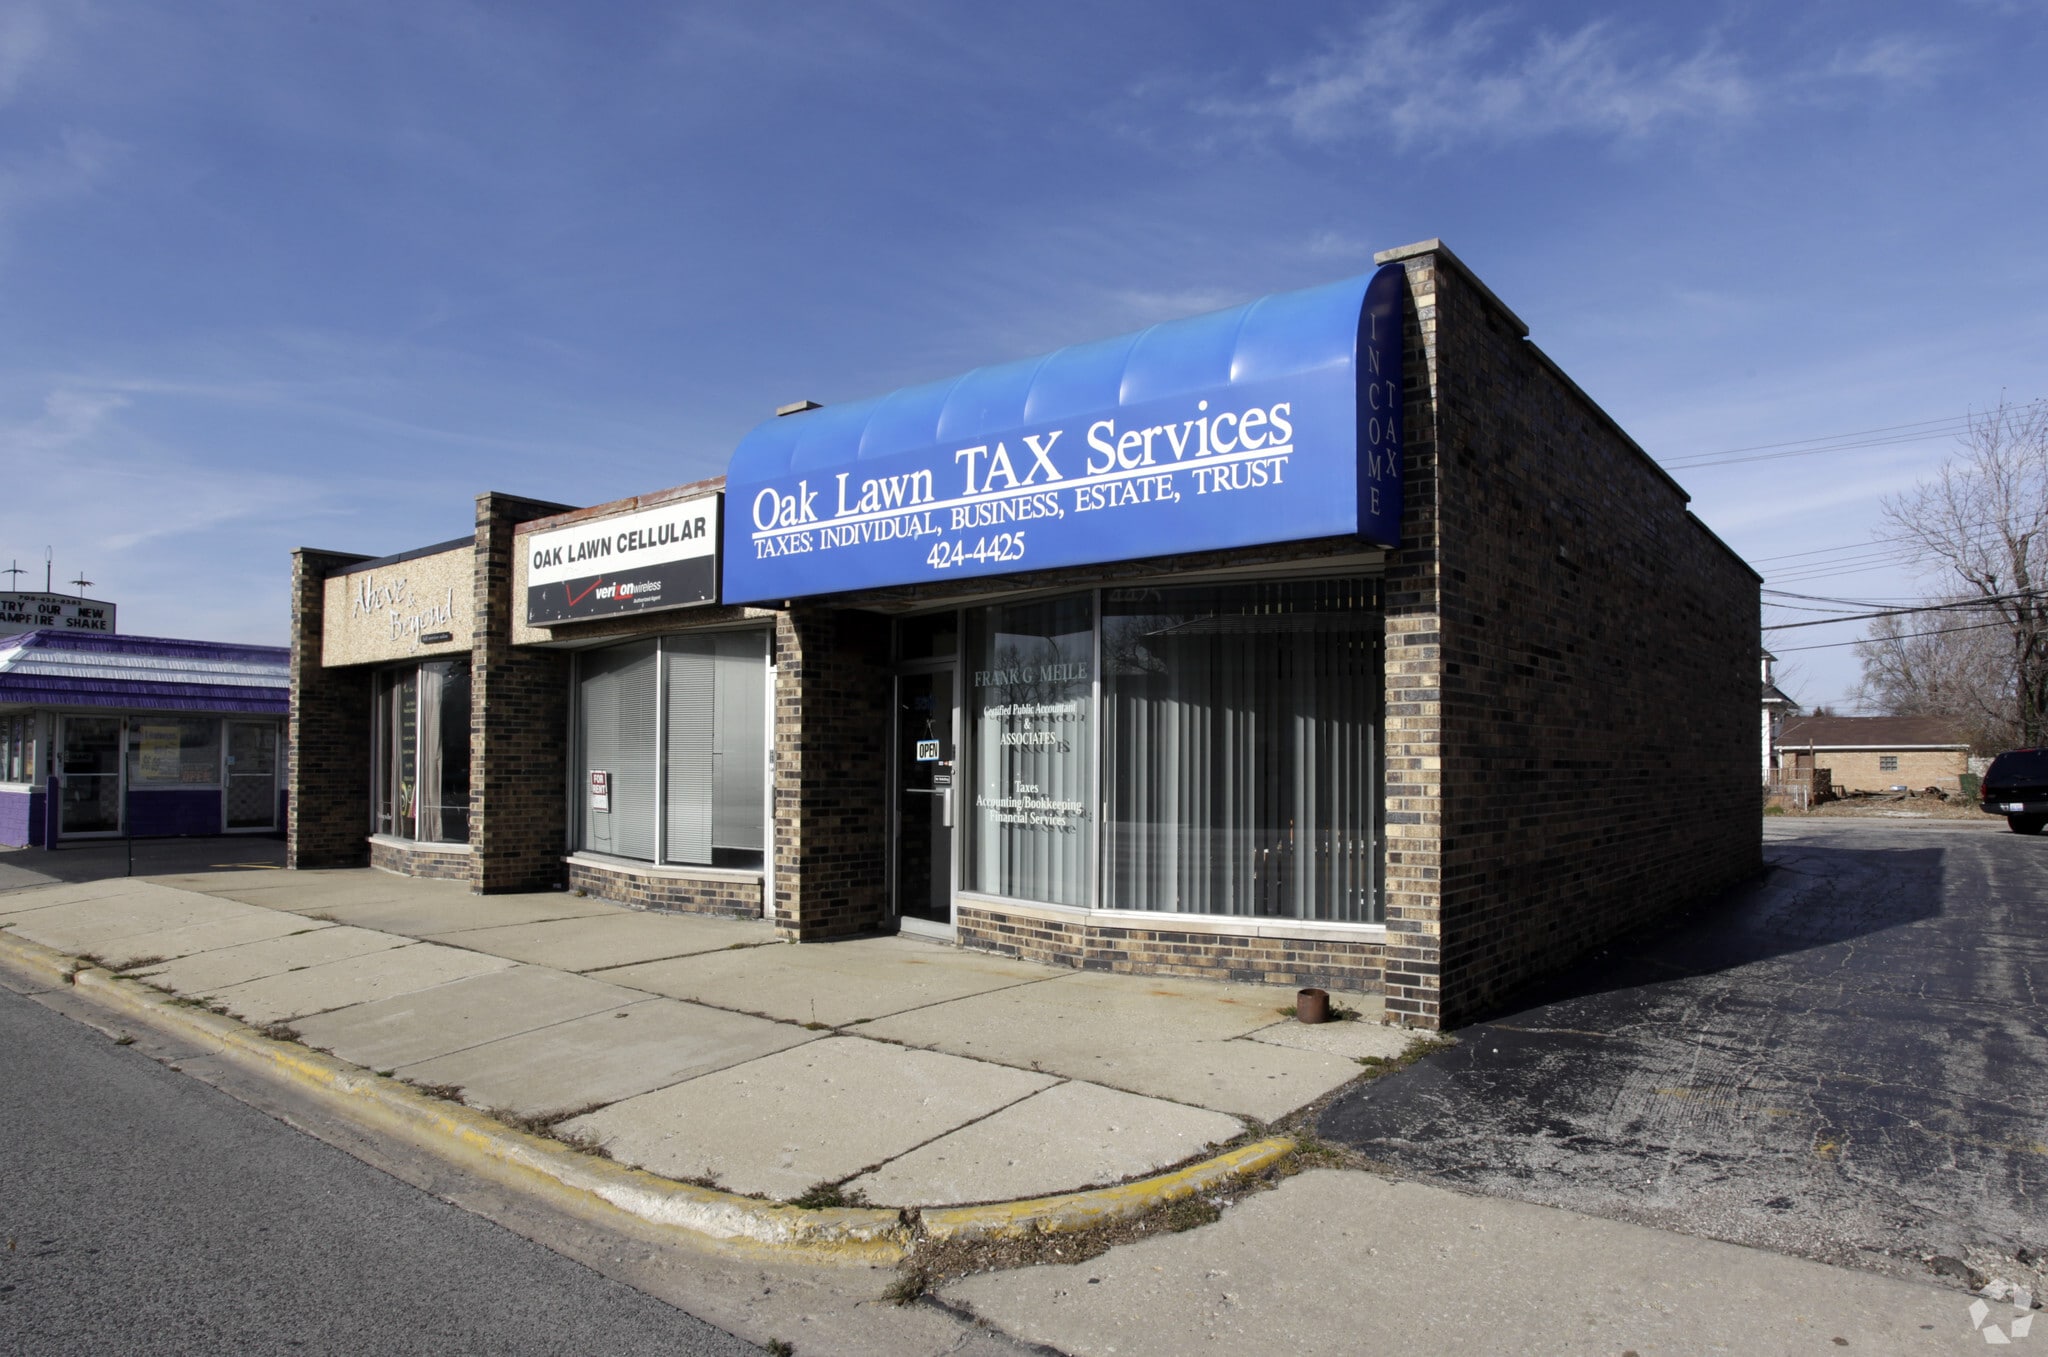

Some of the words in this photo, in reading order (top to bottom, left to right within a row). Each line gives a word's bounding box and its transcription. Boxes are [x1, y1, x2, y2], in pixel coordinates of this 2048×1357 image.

[1367, 312, 1382, 516] INCOME
[1385, 379, 1397, 478] TAX
[752, 480, 818, 530] Oak
[835, 469, 935, 517] Lawn
[955, 430, 1063, 496] TAX
[1087, 400, 1294, 475] Services
[754, 532, 813, 559] TAXES:
[820, 512, 942, 550] INDIVIDUAL,
[951, 492, 1065, 530] BUSINESS,
[1075, 474, 1181, 512] ESTATE,
[1192, 456, 1289, 495] TRUST
[533, 546, 563, 569] OAK
[568, 536, 611, 563] LAWN
[617, 516, 706, 554] CELLULAR
[926, 531, 1025, 569] 424-4425
[353, 575, 407, 618] Above
[1, 600, 25, 611] TRY
[38, 604, 61, 615] OUR
[78, 607, 104, 618] NEW
[66, 618, 107, 630] SHAKE
[389, 587, 453, 653] Beyond
[974, 668, 1020, 687] FRANK
[1022, 667, 1033, 683] G
[984, 703, 1012, 716] Certified
[1013, 703, 1034, 715] Public
[1035, 702, 1076, 714] Accountant
[1024, 718, 1031, 730] &
[1000, 732, 1056, 745] ASSOCIATES
[919, 742, 938, 758] OPEN
[593, 773, 604, 784] FOR
[1014, 780, 1039, 793] Taxes
[592, 784, 606, 794] RENT
[976, 794, 1082, 814] Accounting/Bookkeeping
[990, 811, 1027, 824] Financial
[1029, 812, 1066, 826] Services
